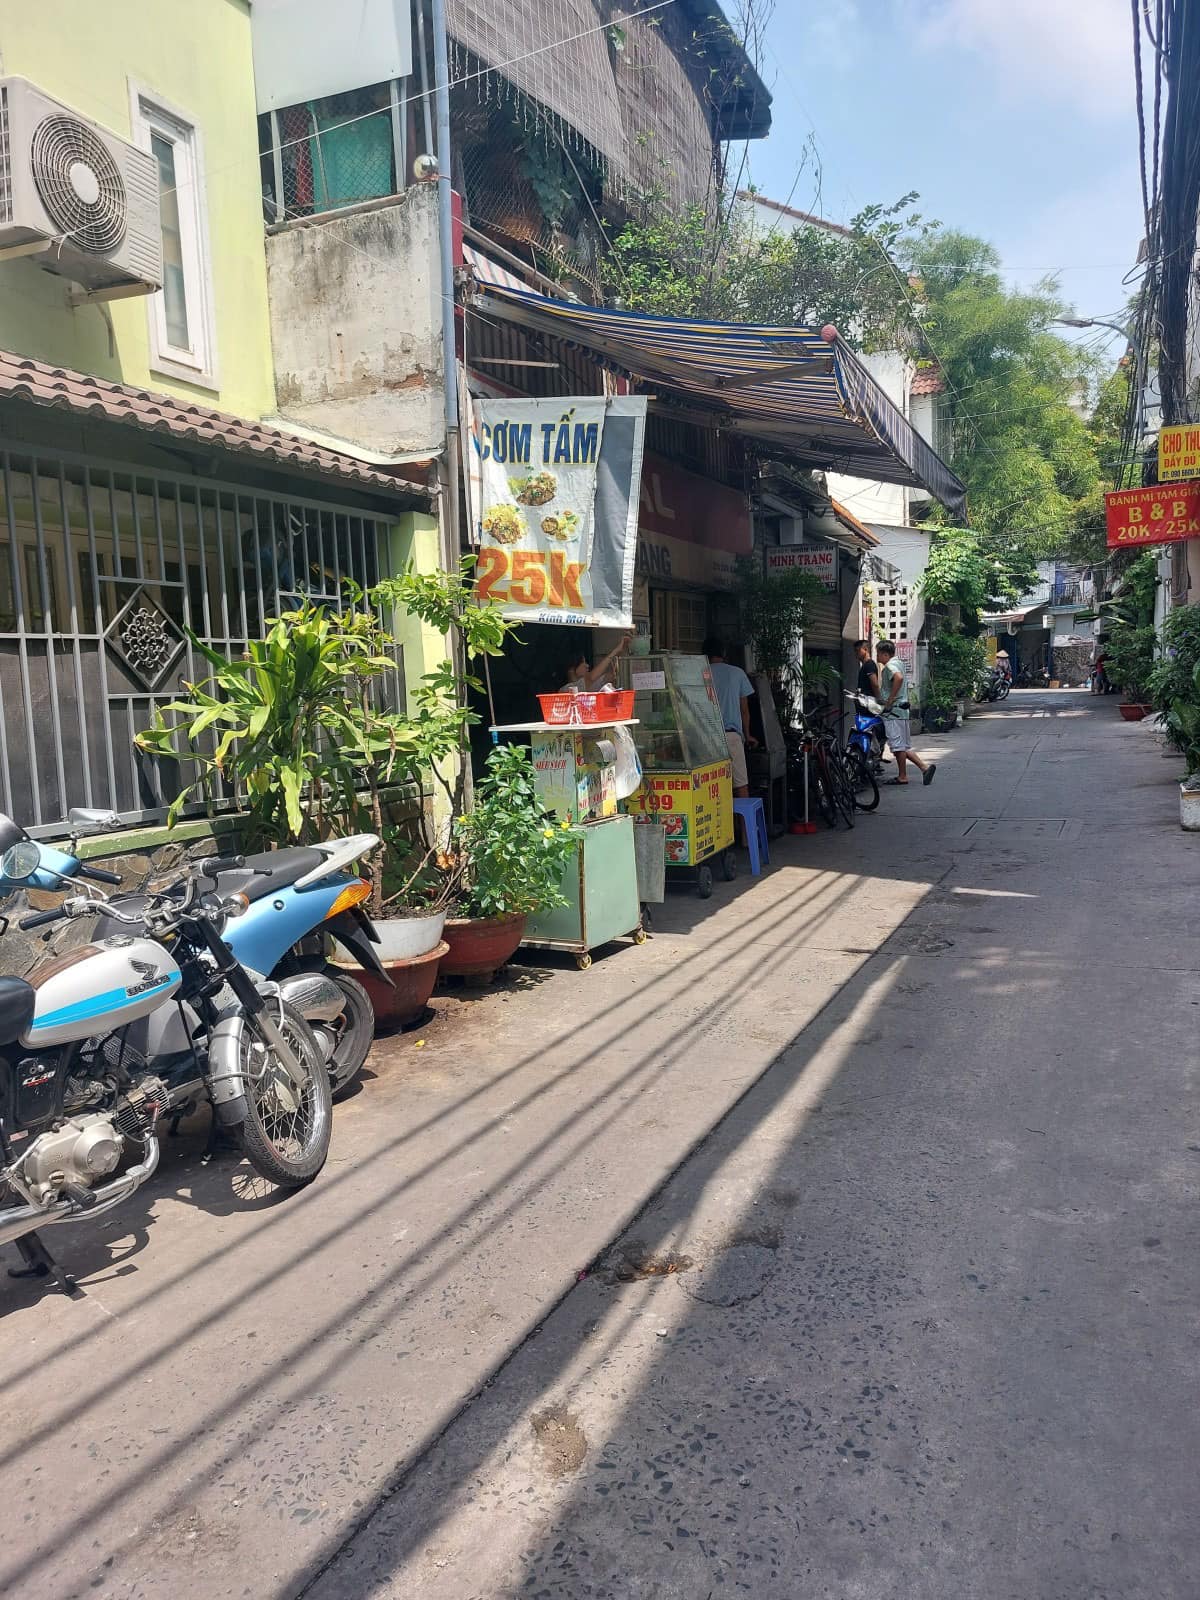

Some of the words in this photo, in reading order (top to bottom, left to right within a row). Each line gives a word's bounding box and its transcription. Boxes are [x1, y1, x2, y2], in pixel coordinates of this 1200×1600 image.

[481, 419, 532, 463] CƠM
[541, 407, 599, 463] TẤM
[1163, 432, 1181, 454] CHO
[1156, 489, 1177, 500] TAM
[1128, 507, 1143, 523] B
[1150, 502, 1165, 520] &
[1172, 501, 1187, 517] B
[1117, 524, 1150, 540] 20K
[1166, 519, 1200, 534] 25K
[769, 555, 796, 567] MINH
[798, 553, 833, 565] TRANG
[667, 779, 690, 790] ĐÊM
[638, 795, 673, 811] 199
